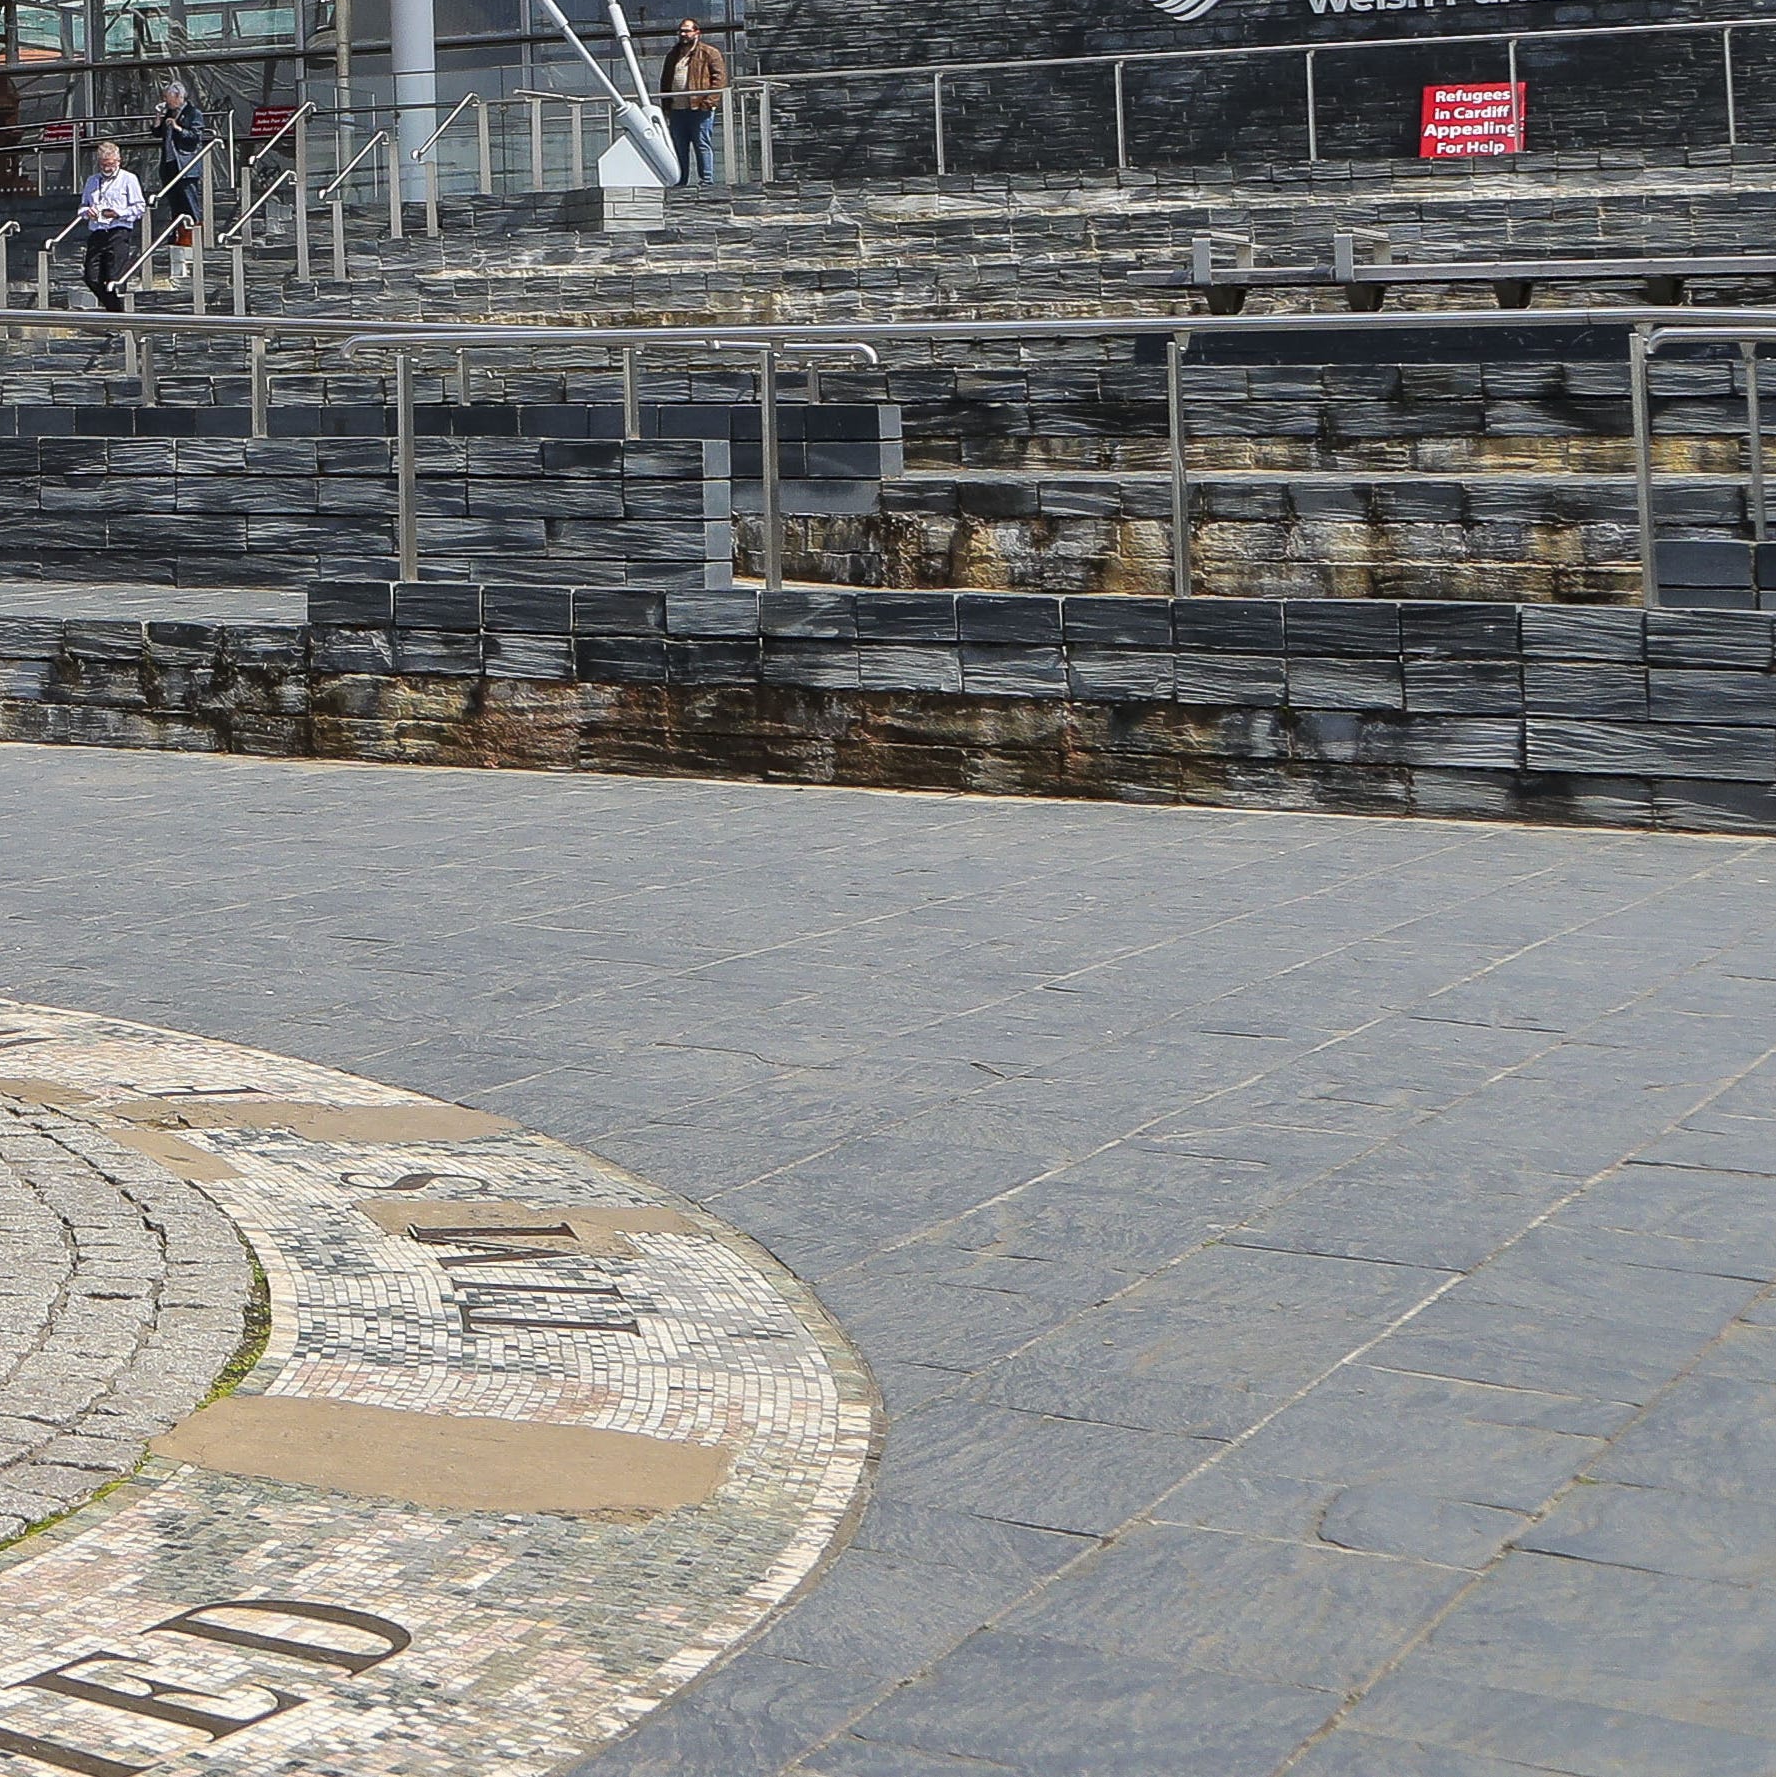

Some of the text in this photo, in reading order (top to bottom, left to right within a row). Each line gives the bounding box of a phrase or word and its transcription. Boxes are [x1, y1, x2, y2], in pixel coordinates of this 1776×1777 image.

[1435, 89, 1511, 104] Refugees
[1434, 105, 1510, 121] in Cardiff
[1436, 140, 1506, 156] For Help
